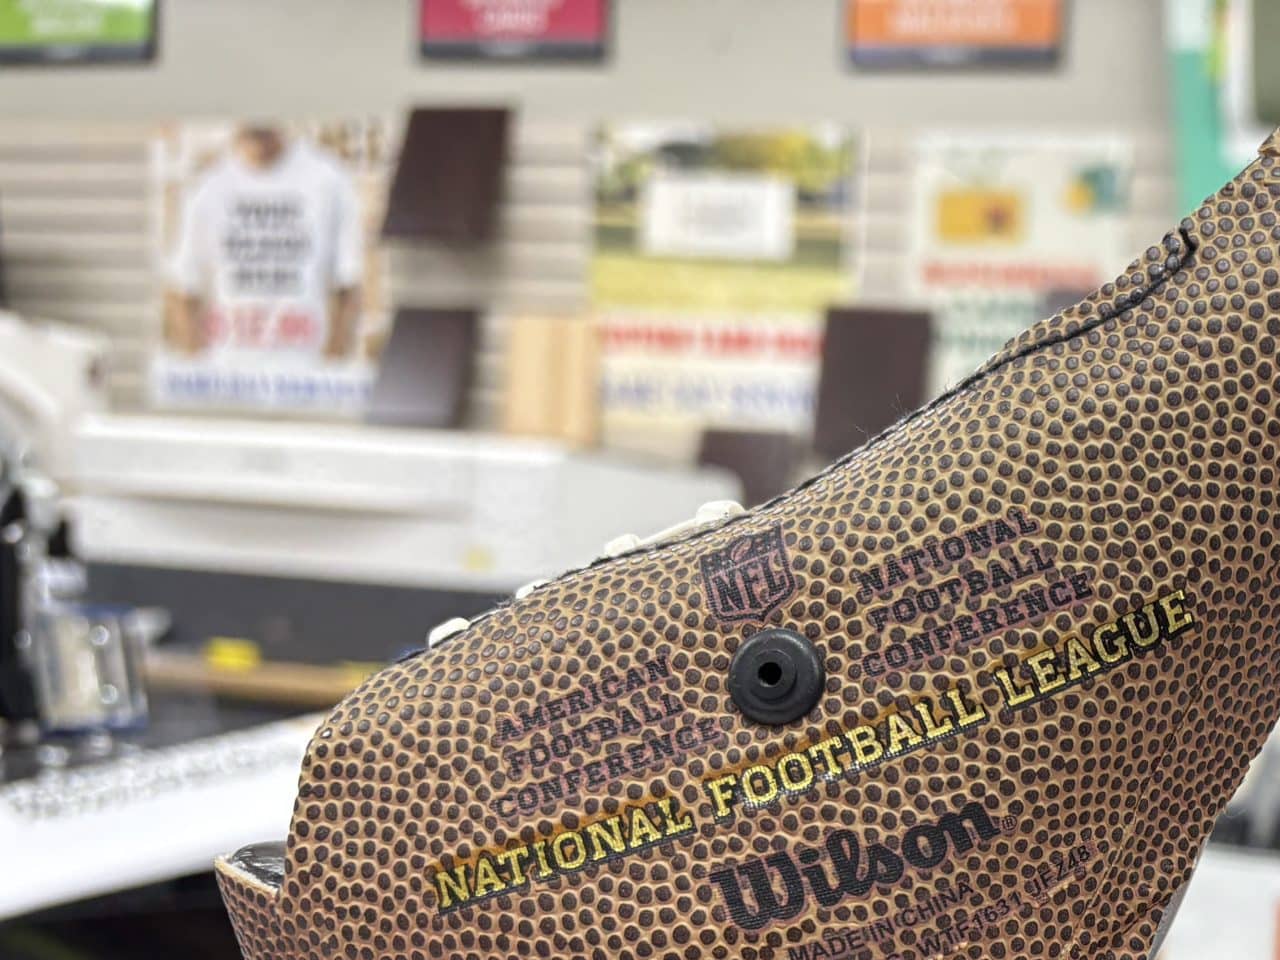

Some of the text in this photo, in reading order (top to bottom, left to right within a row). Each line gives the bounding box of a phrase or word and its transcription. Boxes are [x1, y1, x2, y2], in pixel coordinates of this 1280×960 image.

[712, 552, 789, 614] NFL
[857, 510, 1039, 597] NATIONAL
[869, 548, 1055, 633] FOOTBALL
[862, 572, 1093, 678] CONFERENCE
[498, 654, 673, 742] AMERICAN
[506, 693, 685, 779] FOOTBALL
[435, 590, 1195, 911] NATIONAL FOOTBALL LEAGUE
[496, 717, 721, 818] CONFERENCE
[709, 801, 1001, 931] Wilson
[870, 919, 896, 943] IN
[900, 882, 974, 927] CHINA
